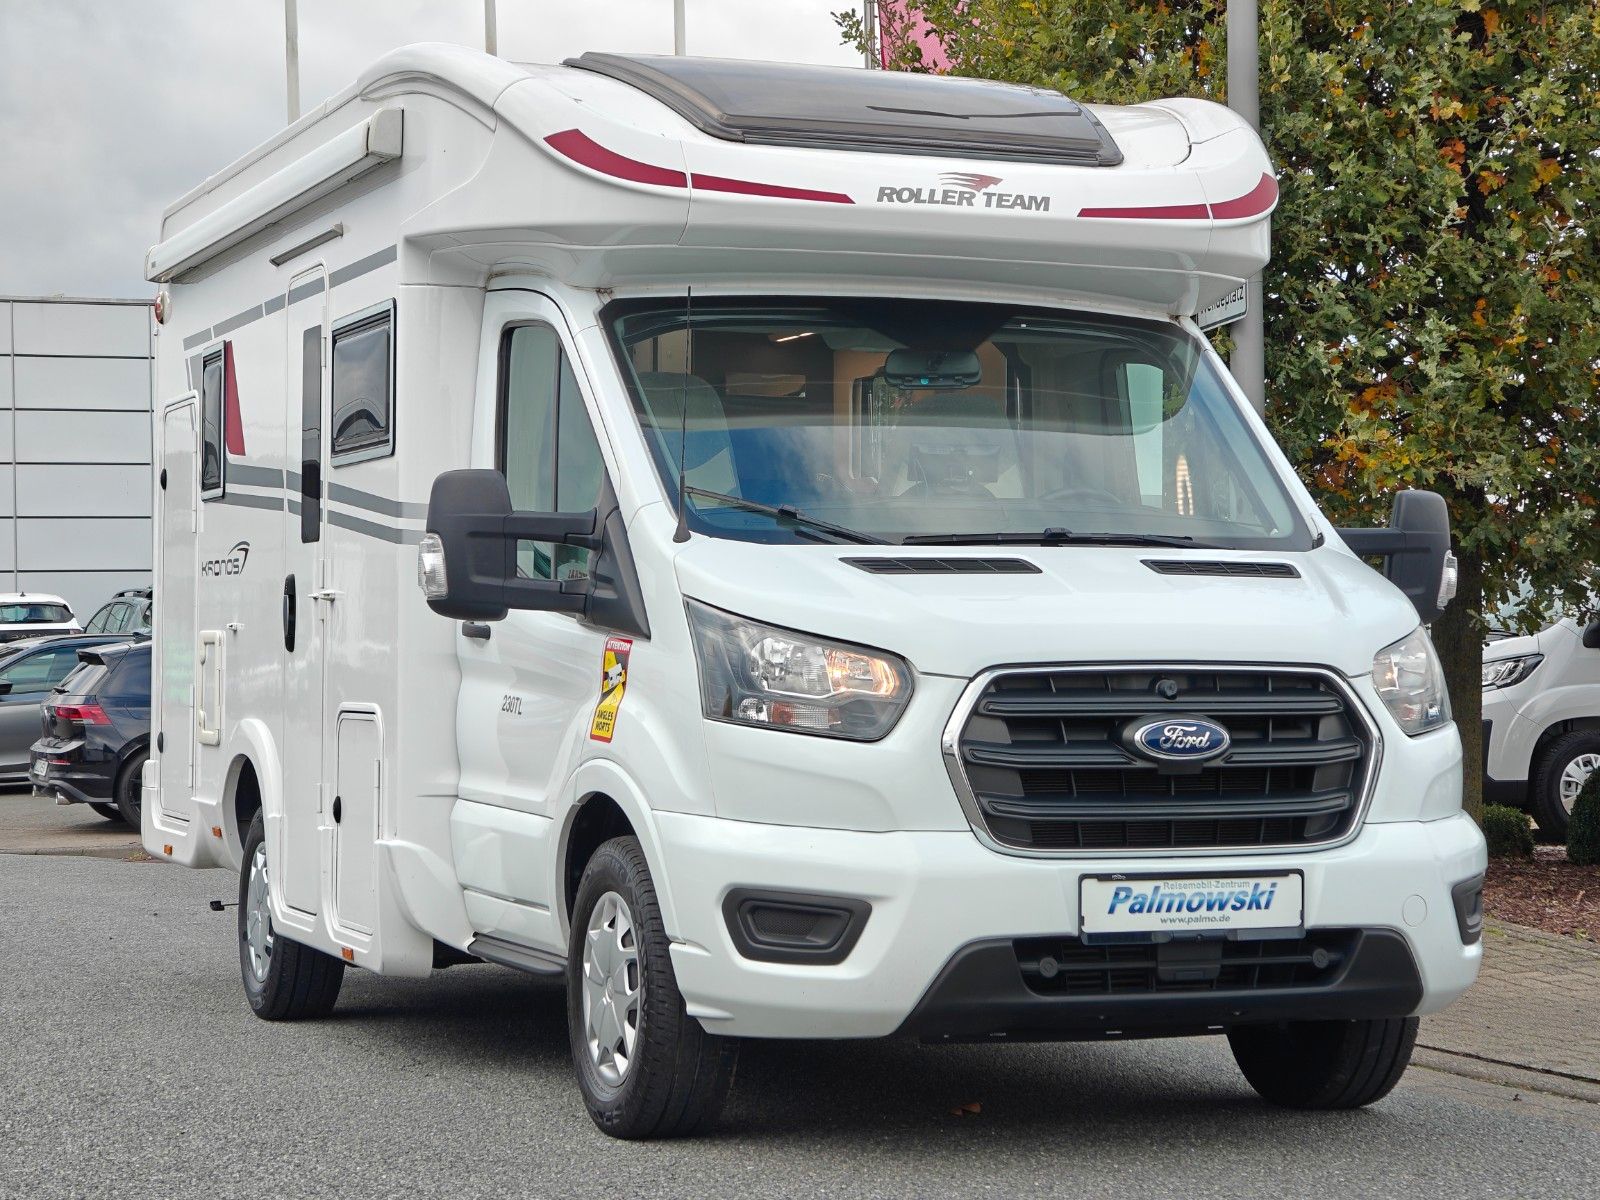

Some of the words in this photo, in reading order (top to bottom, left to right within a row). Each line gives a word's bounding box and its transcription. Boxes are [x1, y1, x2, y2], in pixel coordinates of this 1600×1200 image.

[877, 186, 976, 206] ROLLER
[982, 191, 1050, 212] TEAM
[501, 694, 522, 715] 230TL
[597, 709, 614, 721] ANGLES
[1160, 725, 1210, 749] Ford
[1163, 880, 1250, 890] Reisemobil-Zentrum
[1107, 882, 1278, 915] Palmowski
[1160, 913, 1231, 925] www.palmo.de
